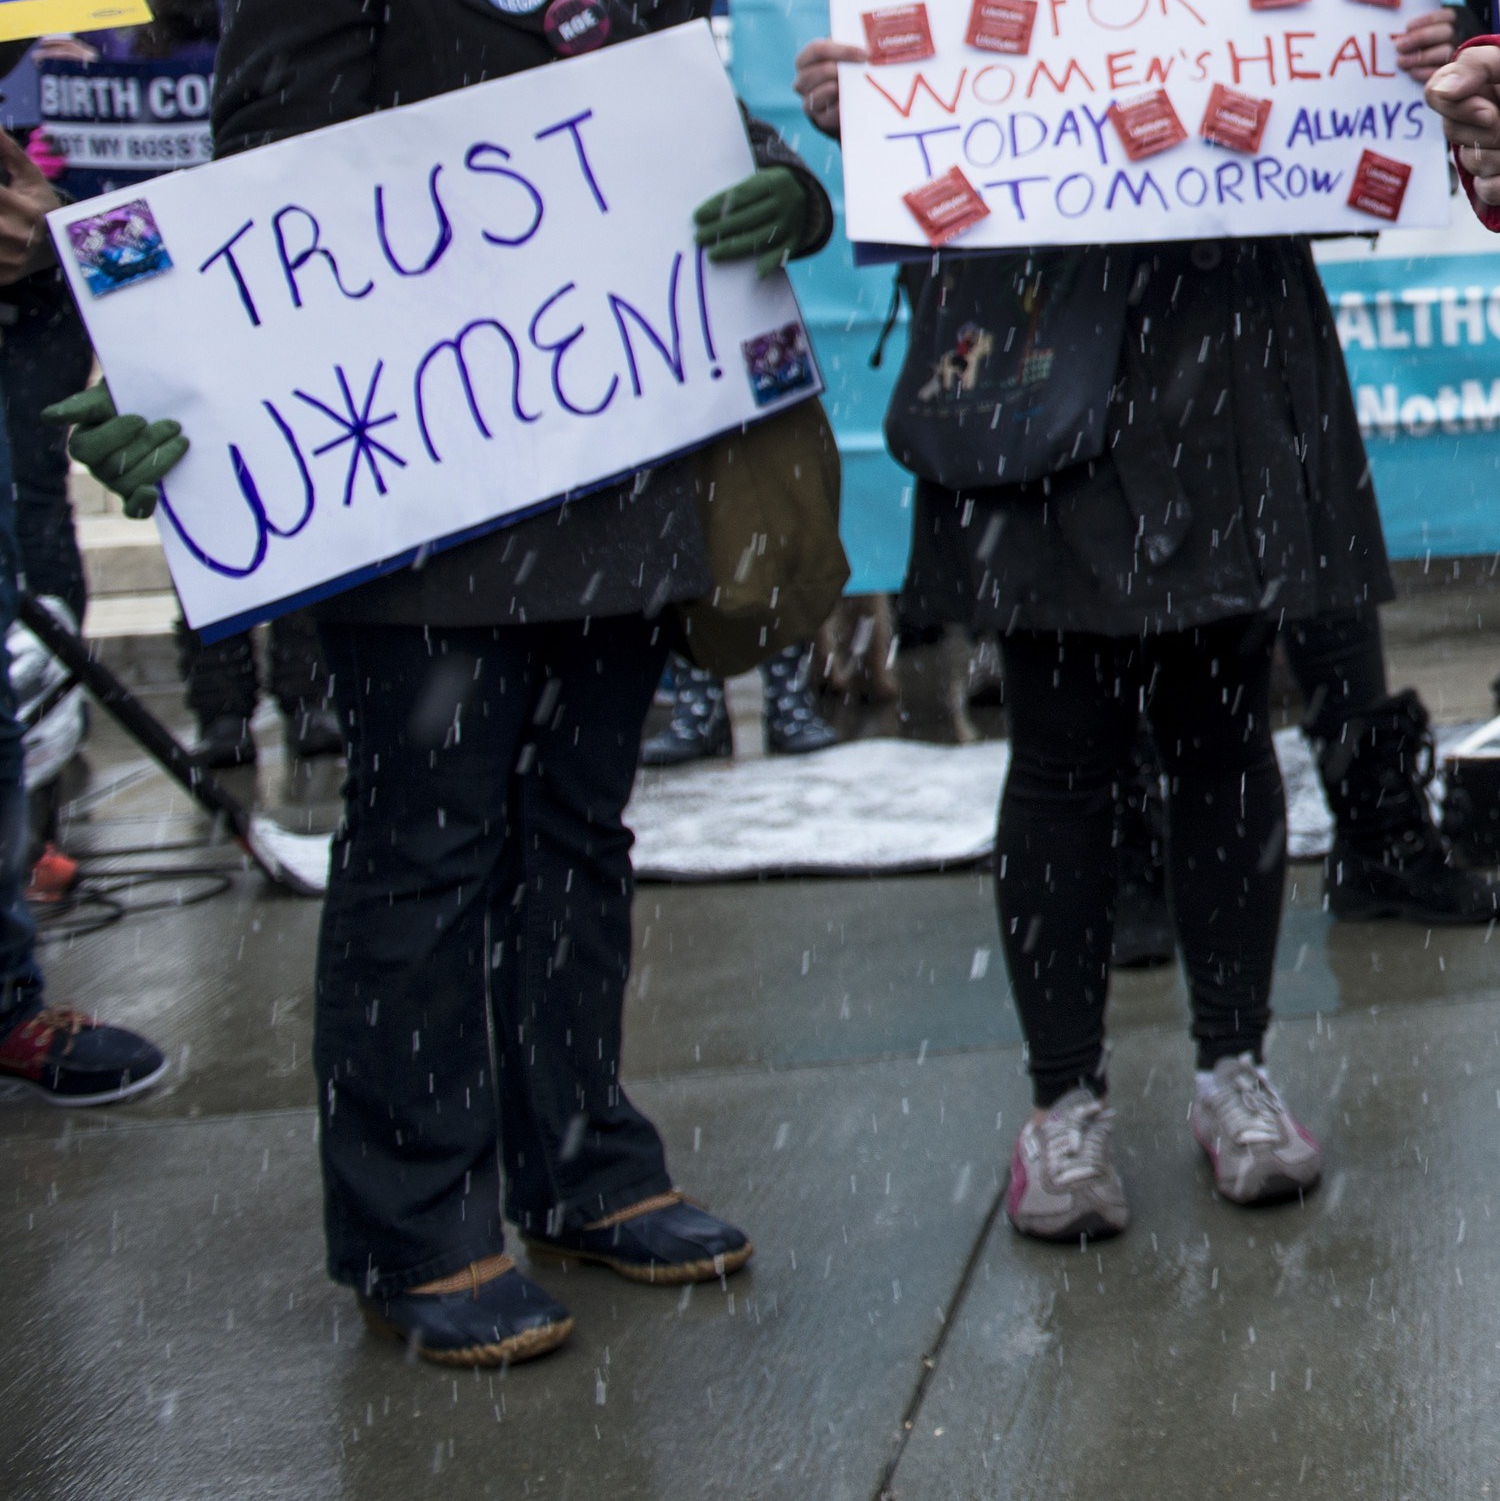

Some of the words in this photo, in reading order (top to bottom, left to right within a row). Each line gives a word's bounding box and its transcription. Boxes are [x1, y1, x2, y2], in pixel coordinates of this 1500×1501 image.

[40, 73, 142, 119] BIRTH
[864, 48, 1213, 118] WOMEN'S
[89, 136, 122, 159] MY
[885, 100, 1119, 178] TODAY
[1286, 100, 1425, 149] ALWAYS
[199, 109, 610, 327] TRUST
[982, 157, 1344, 222] TOMORROW
